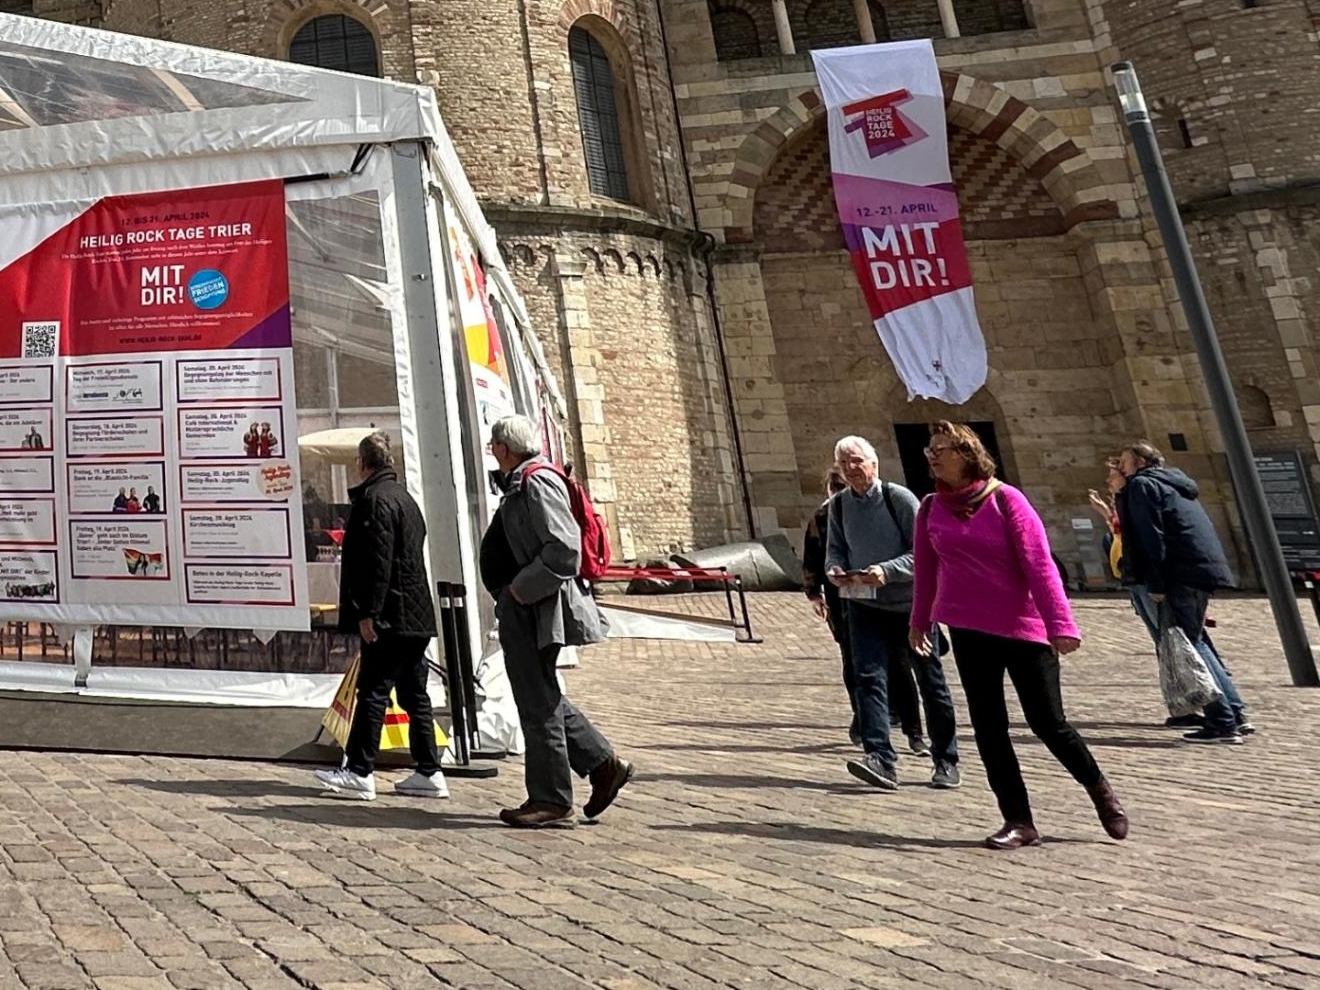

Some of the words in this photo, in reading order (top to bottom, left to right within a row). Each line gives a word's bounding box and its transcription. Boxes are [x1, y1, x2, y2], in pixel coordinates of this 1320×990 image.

[866, 107, 892, 115] HEILIG
[867, 114, 892, 122] ROCK
[868, 121, 894, 130] TAGE
[869, 130, 895, 139] 2024
[901, 203, 938, 215] APRIL
[80, 232, 123, 249] HEILIG
[126, 228, 165, 245] ROCK
[168, 225, 206, 242] TAGE
[210, 222, 252, 238] TRIER
[862, 221, 940, 258] MIT
[141, 265, 185, 287] MIT
[870, 258, 950, 290] DIR!
[141, 287, 184, 306] DIR!
